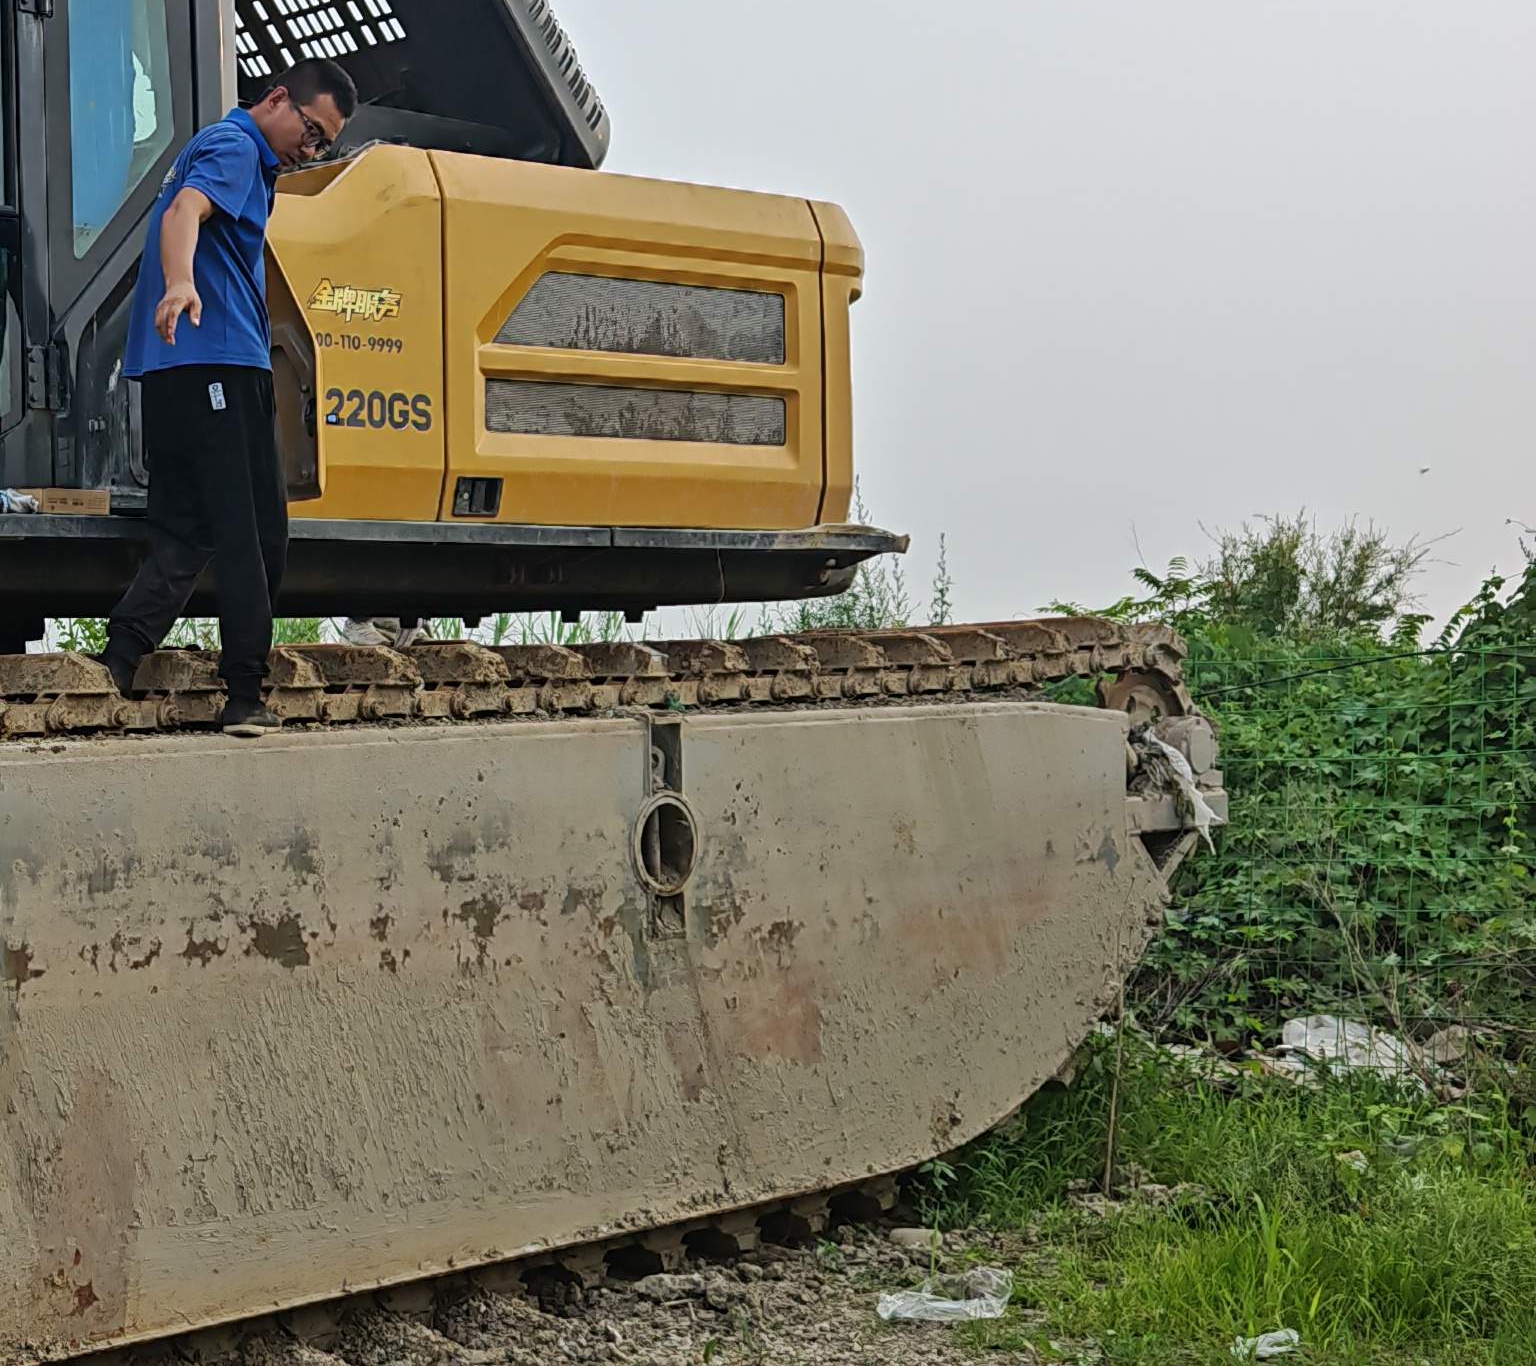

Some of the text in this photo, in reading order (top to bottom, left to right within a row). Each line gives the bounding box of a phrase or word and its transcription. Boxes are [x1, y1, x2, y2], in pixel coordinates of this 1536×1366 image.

[307, 278, 402, 323] 金牌服务
[325, 387, 432, 431] 220GS
